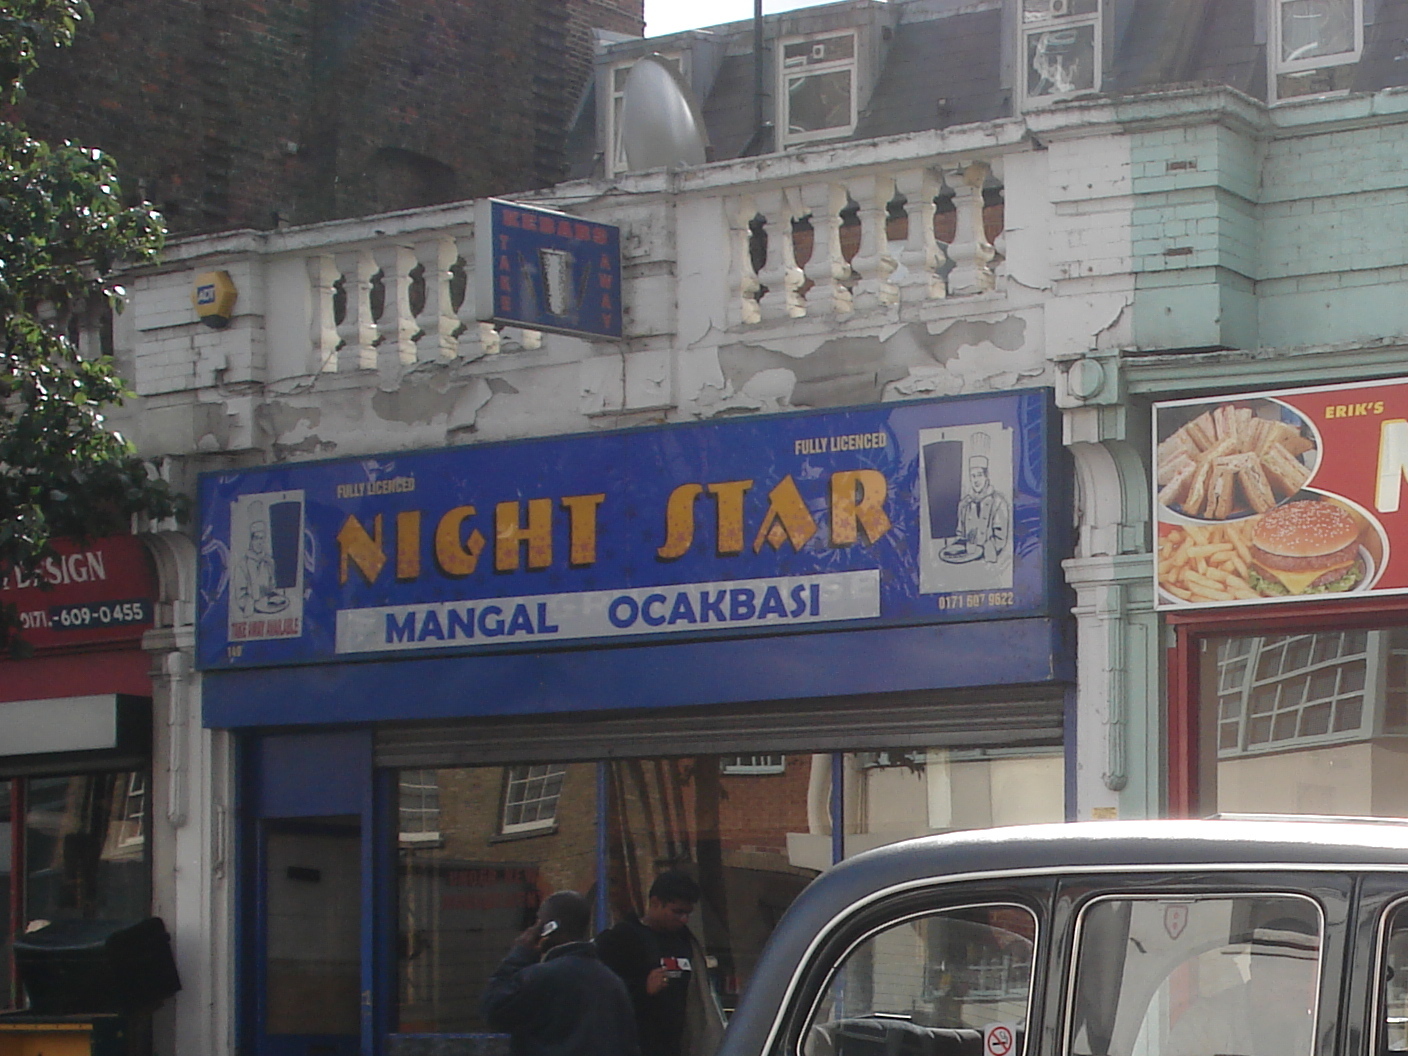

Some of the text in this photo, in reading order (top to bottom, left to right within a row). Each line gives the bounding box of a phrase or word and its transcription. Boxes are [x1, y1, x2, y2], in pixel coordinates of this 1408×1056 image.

[502, 209, 608, 245] KEBABS
[499, 234, 511, 312] TAKE
[598, 253, 614, 329] AWAY
[1325, 400, 1386, 420] ERIK'S
[795, 432, 887, 456] FULLY LICENCED
[336, 477, 415, 499] FULLY LICENCED
[336, 468, 893, 587] NIGHT STAR
[14, 551, 107, 589] DSIGN
[385, 582, 822, 645] MANGAL OCAKBASI
[938, 595, 964, 610] 0171
[988, 591, 1014, 606] 9622
